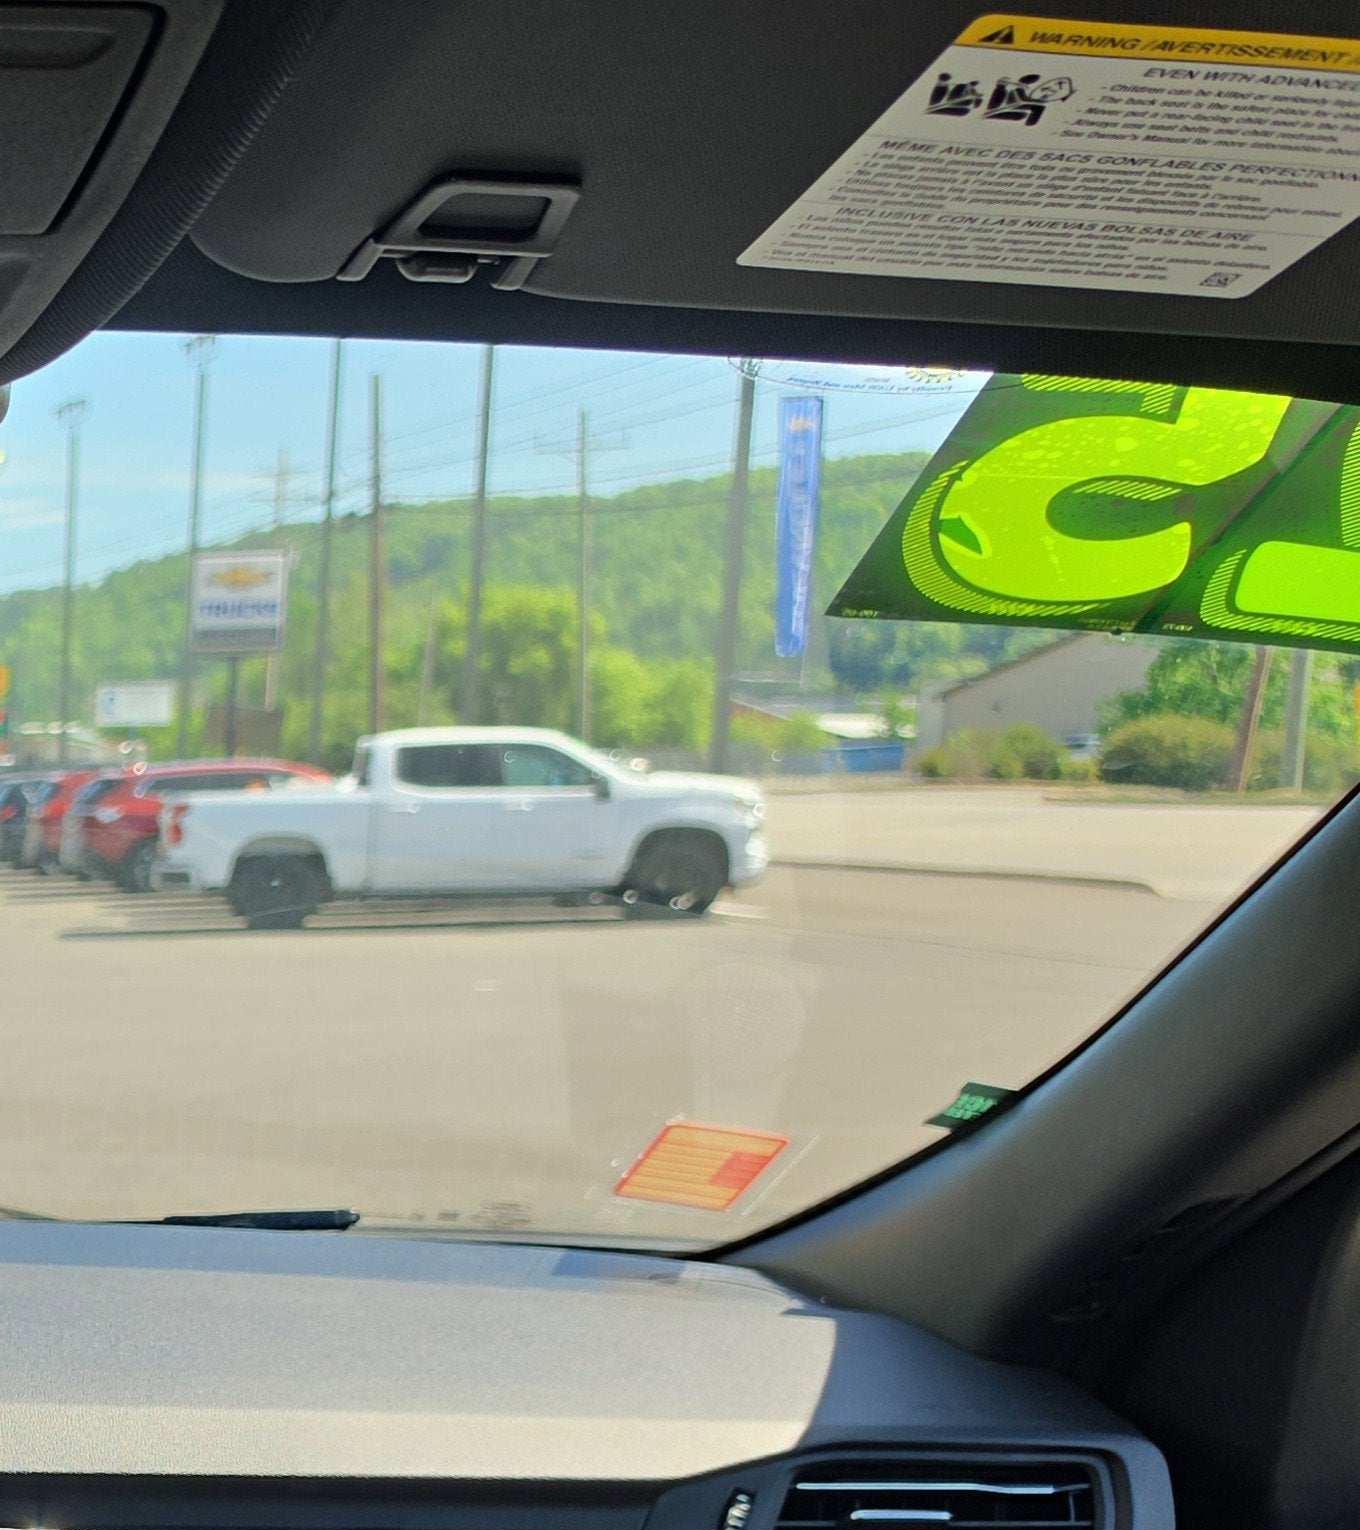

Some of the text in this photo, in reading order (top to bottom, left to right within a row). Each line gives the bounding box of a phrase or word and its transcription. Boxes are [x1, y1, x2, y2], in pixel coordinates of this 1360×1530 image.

[1030, 31, 1141, 50] WARNING
[1143, 67, 1360, 91] EVEN WITH ADVANCE
[879, 140, 1360, 182] MÊME AVEC DES SACS GONFLABLES PERFECTIONN
[836, 207, 1255, 242] INCLUSIVE CON LAS NUEVAS BOLSAS DE AIRE
